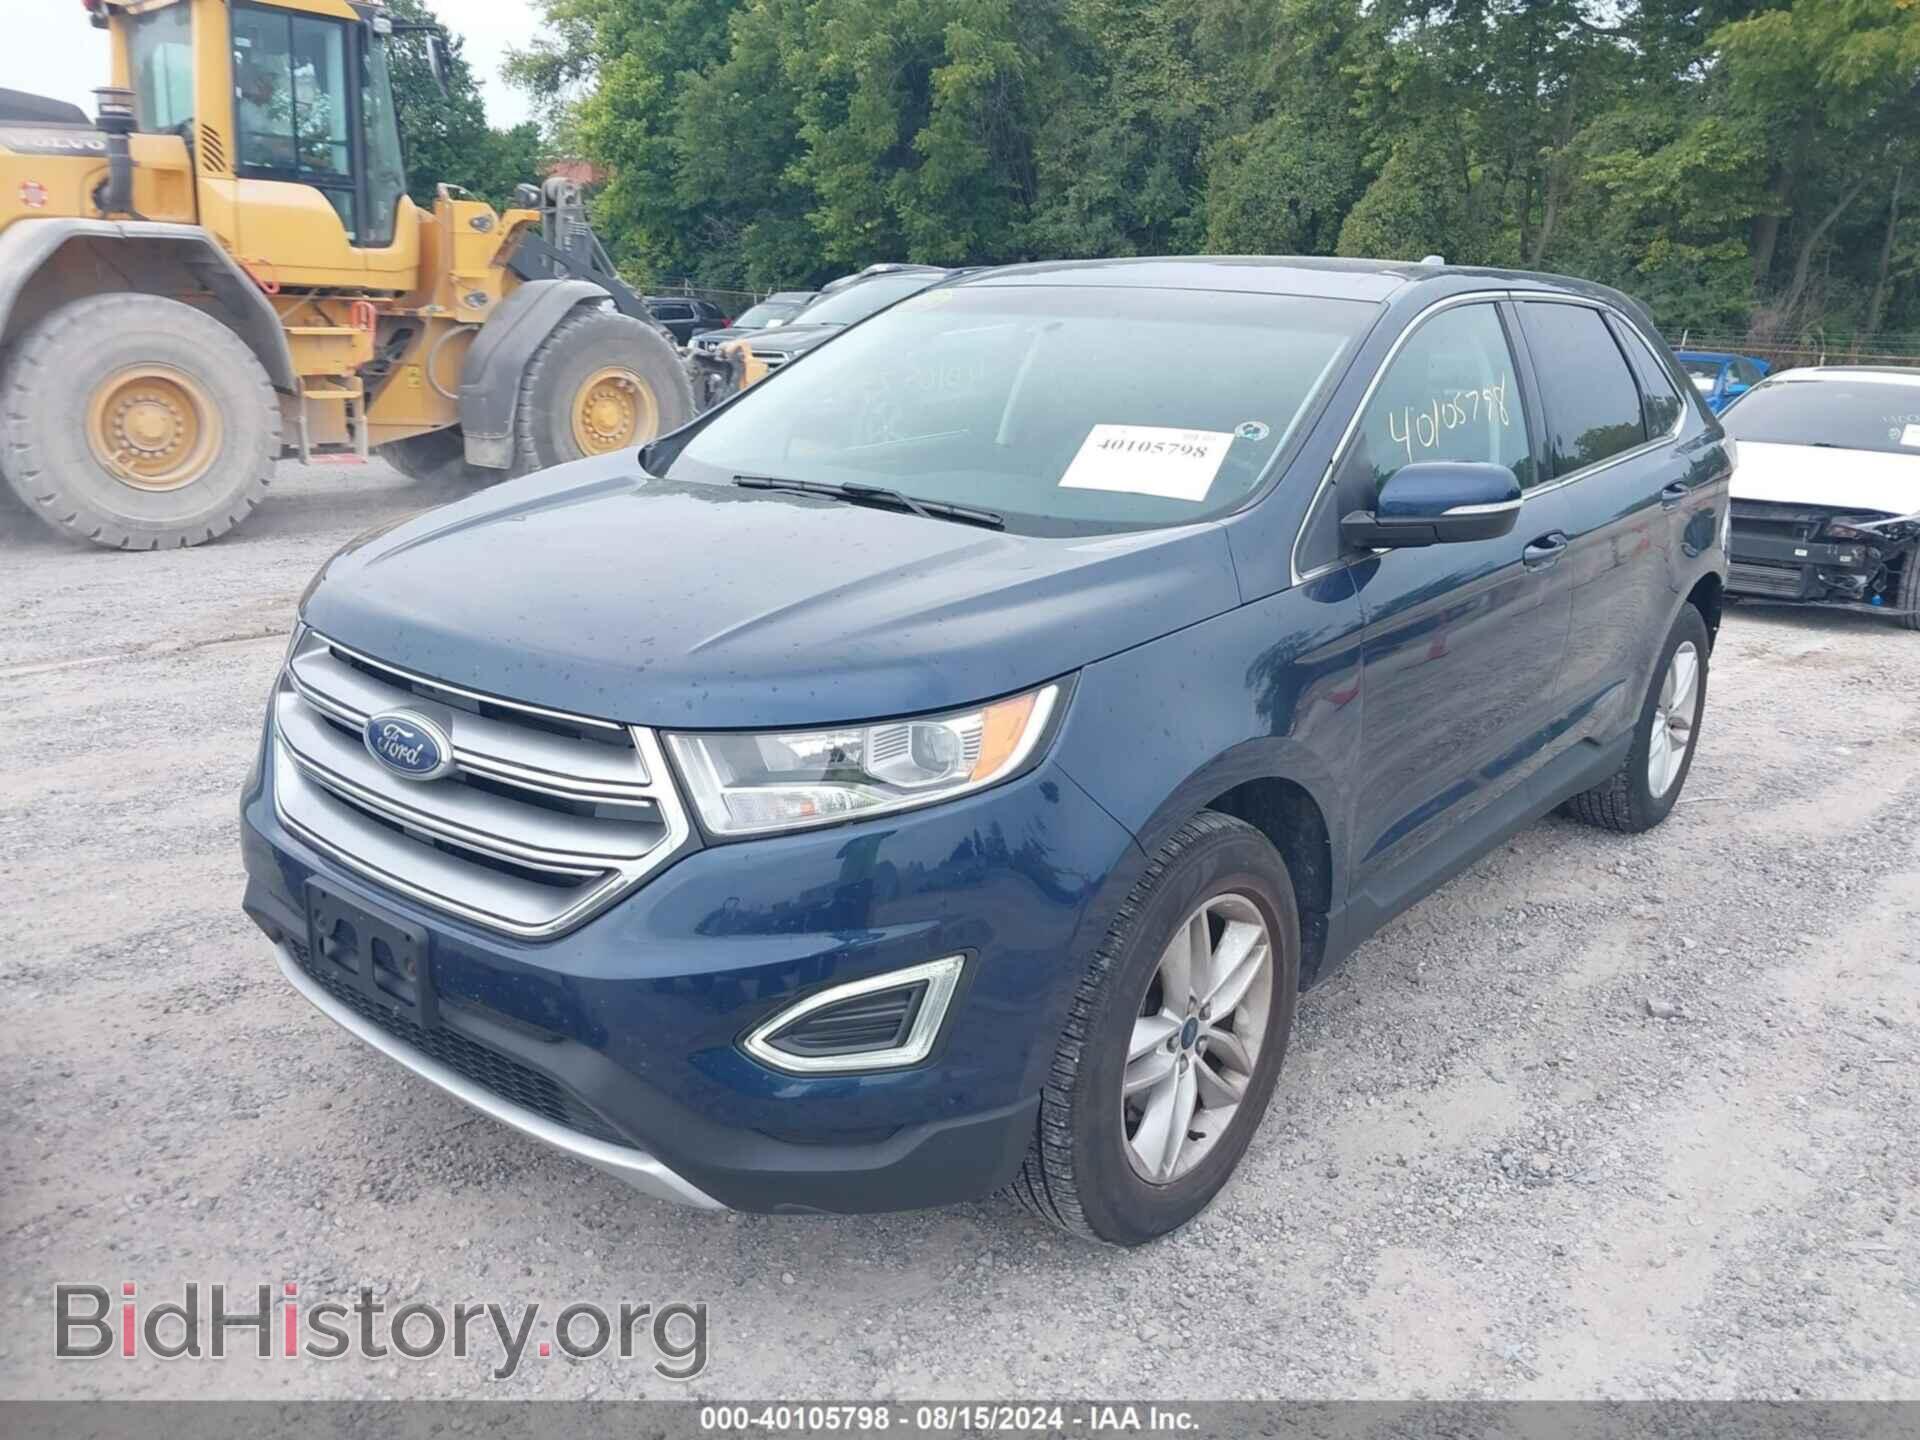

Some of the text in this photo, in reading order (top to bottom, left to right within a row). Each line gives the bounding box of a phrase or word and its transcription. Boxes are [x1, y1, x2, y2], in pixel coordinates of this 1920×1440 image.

[1389, 370, 1509, 463] 40105798
[1097, 438, 1208, 457] 40105798
[377, 723, 424, 765] Ford
